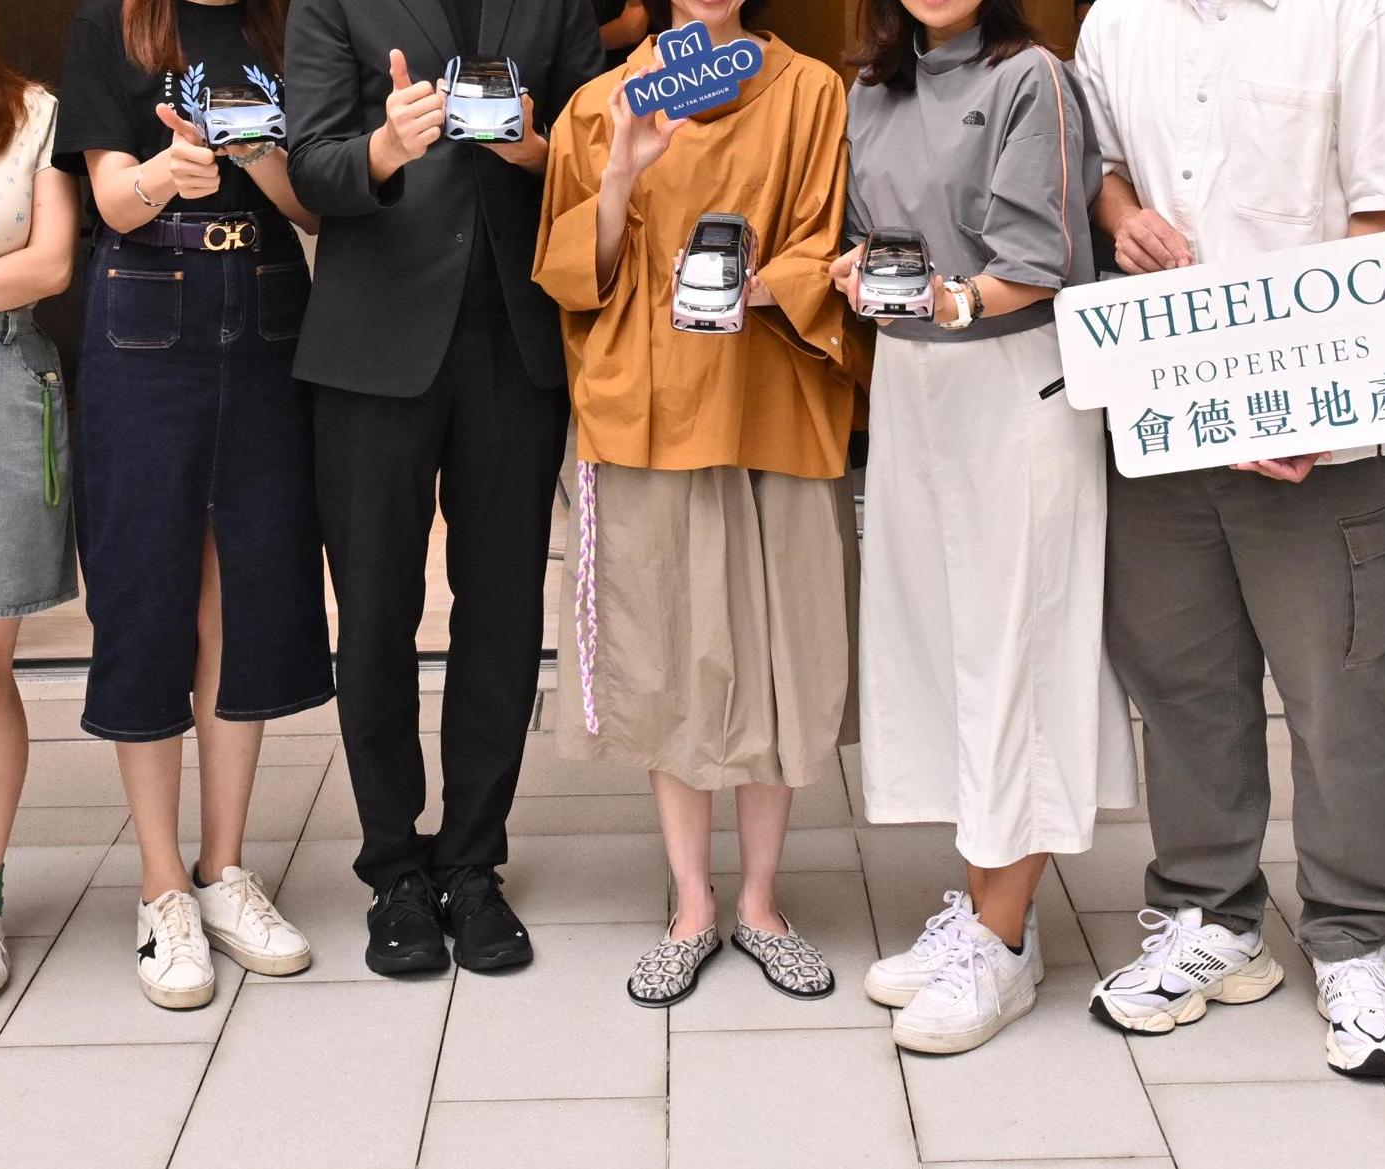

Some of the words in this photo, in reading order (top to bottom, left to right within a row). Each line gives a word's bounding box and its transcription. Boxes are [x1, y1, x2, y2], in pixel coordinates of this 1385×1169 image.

[634, 49, 753, 107] MONACO
[686, 98, 698, 106] TAK
[699, 86, 730, 101] HARBOUR
[1150, 335, 1371, 390] PROPERTIES
